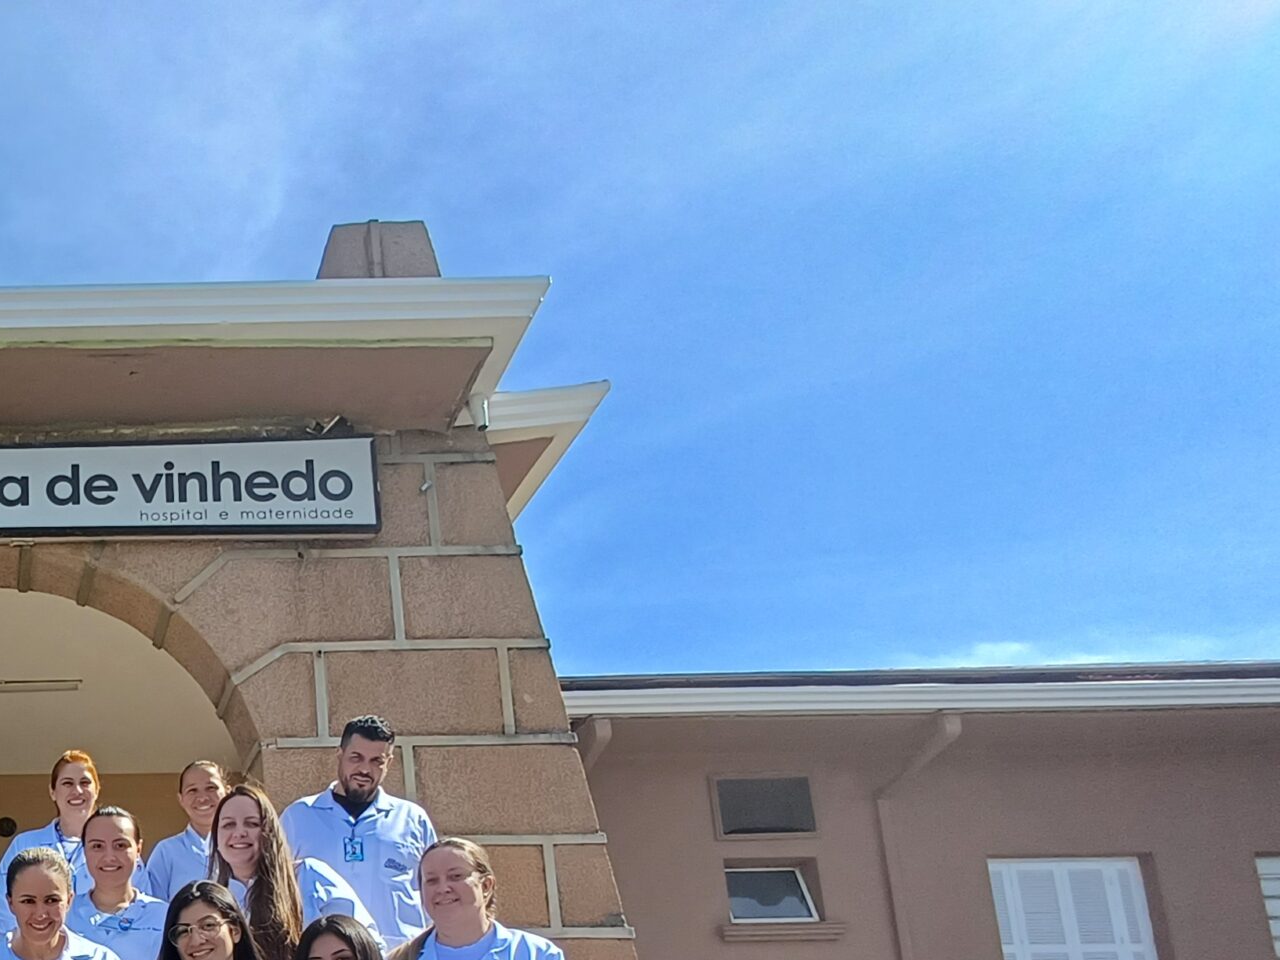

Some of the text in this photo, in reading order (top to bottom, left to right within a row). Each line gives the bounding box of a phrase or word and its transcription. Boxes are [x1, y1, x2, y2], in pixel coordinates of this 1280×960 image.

[45, 463, 119, 506] de
[131, 459, 353, 504] vinhedo
[139, 507, 354, 523] hospital e maternidade
